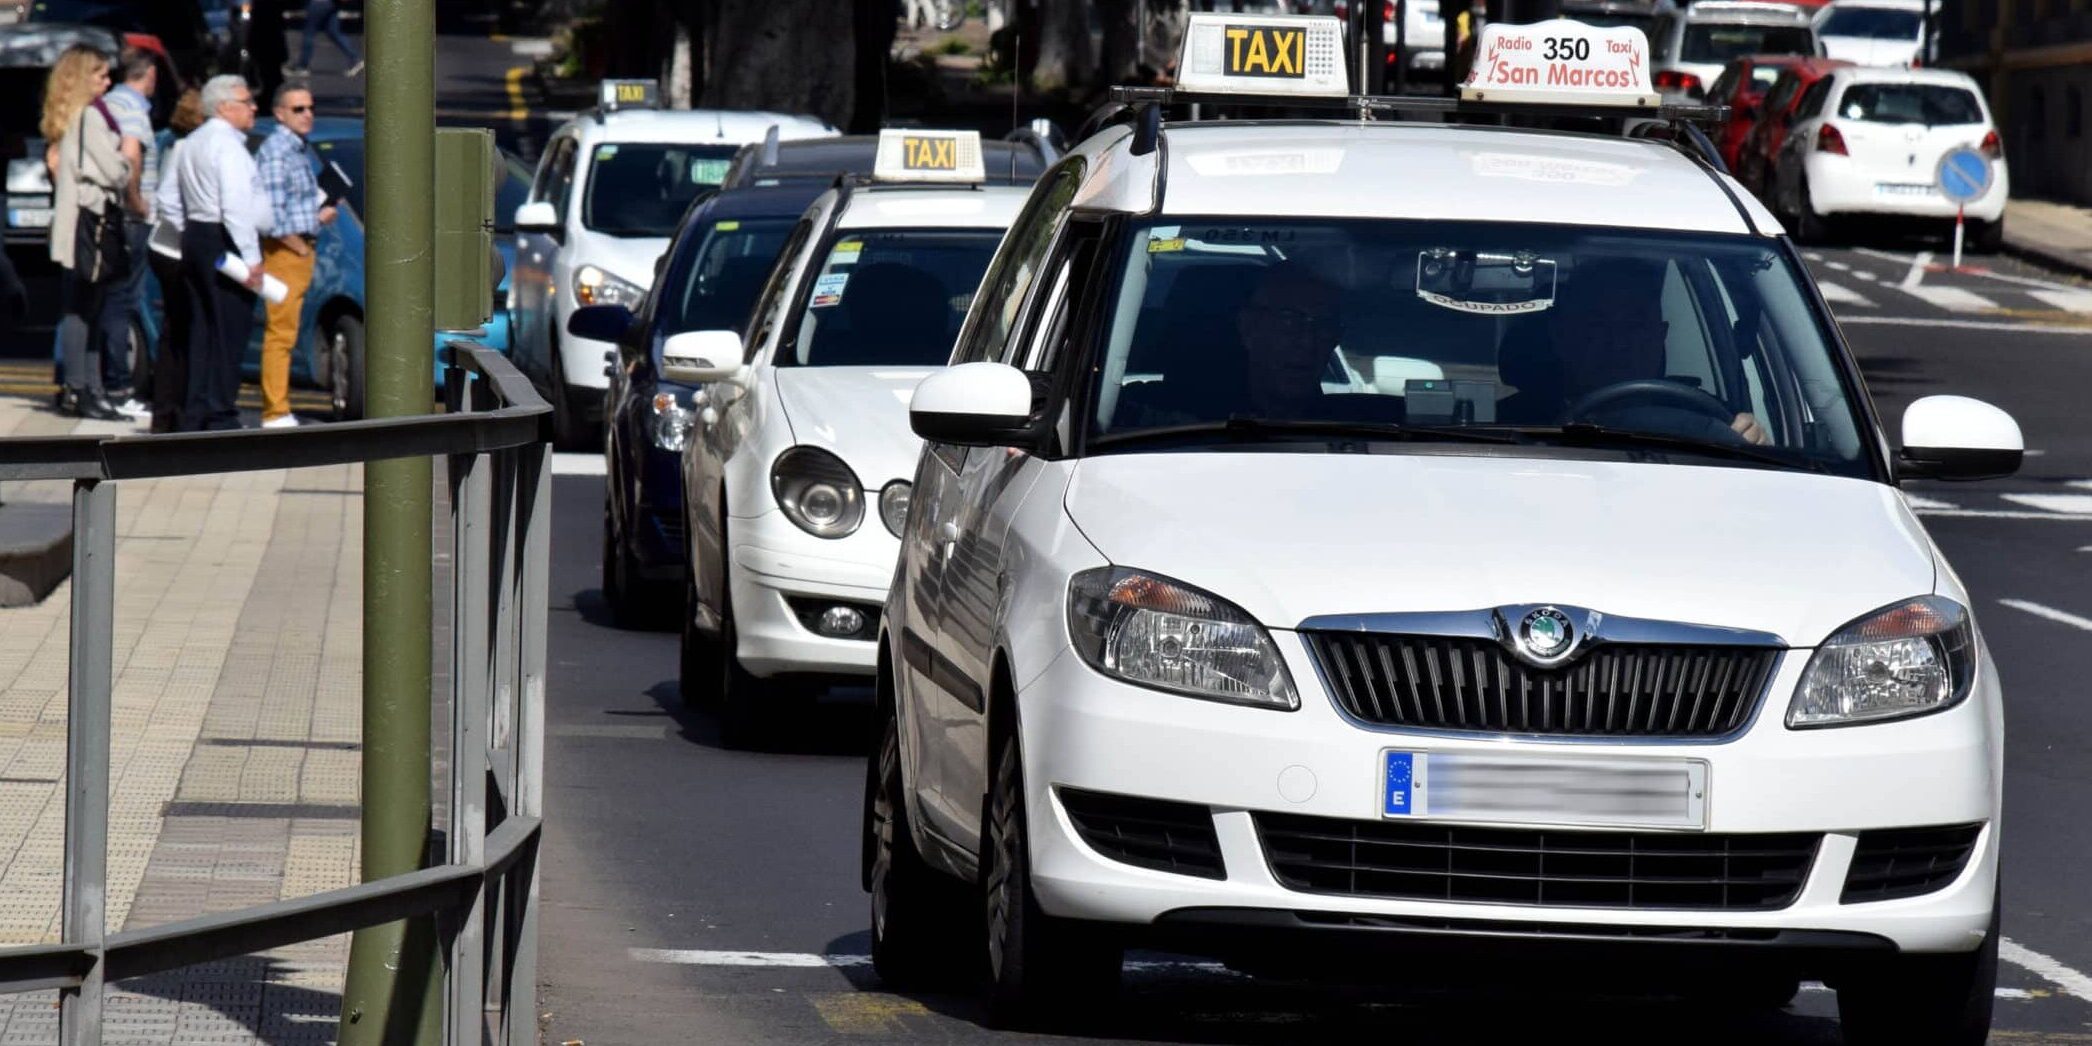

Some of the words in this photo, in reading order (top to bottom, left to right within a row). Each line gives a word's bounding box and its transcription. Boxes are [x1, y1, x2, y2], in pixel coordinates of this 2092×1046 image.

[1226, 28, 1304, 74] TAXI
[1497, 36, 1533, 50] Radio
[1543, 37, 1590, 61] 350
[1606, 39, 1632, 54] Taxi
[1497, 60, 1539, 85] San
[1547, 63, 1630, 88] Marcos
[618, 84, 645, 102] TAXI
[905, 138, 955, 169] TAXI
[1433, 294, 1537, 312] OCUPADO
[1393, 791, 1405, 805] E
